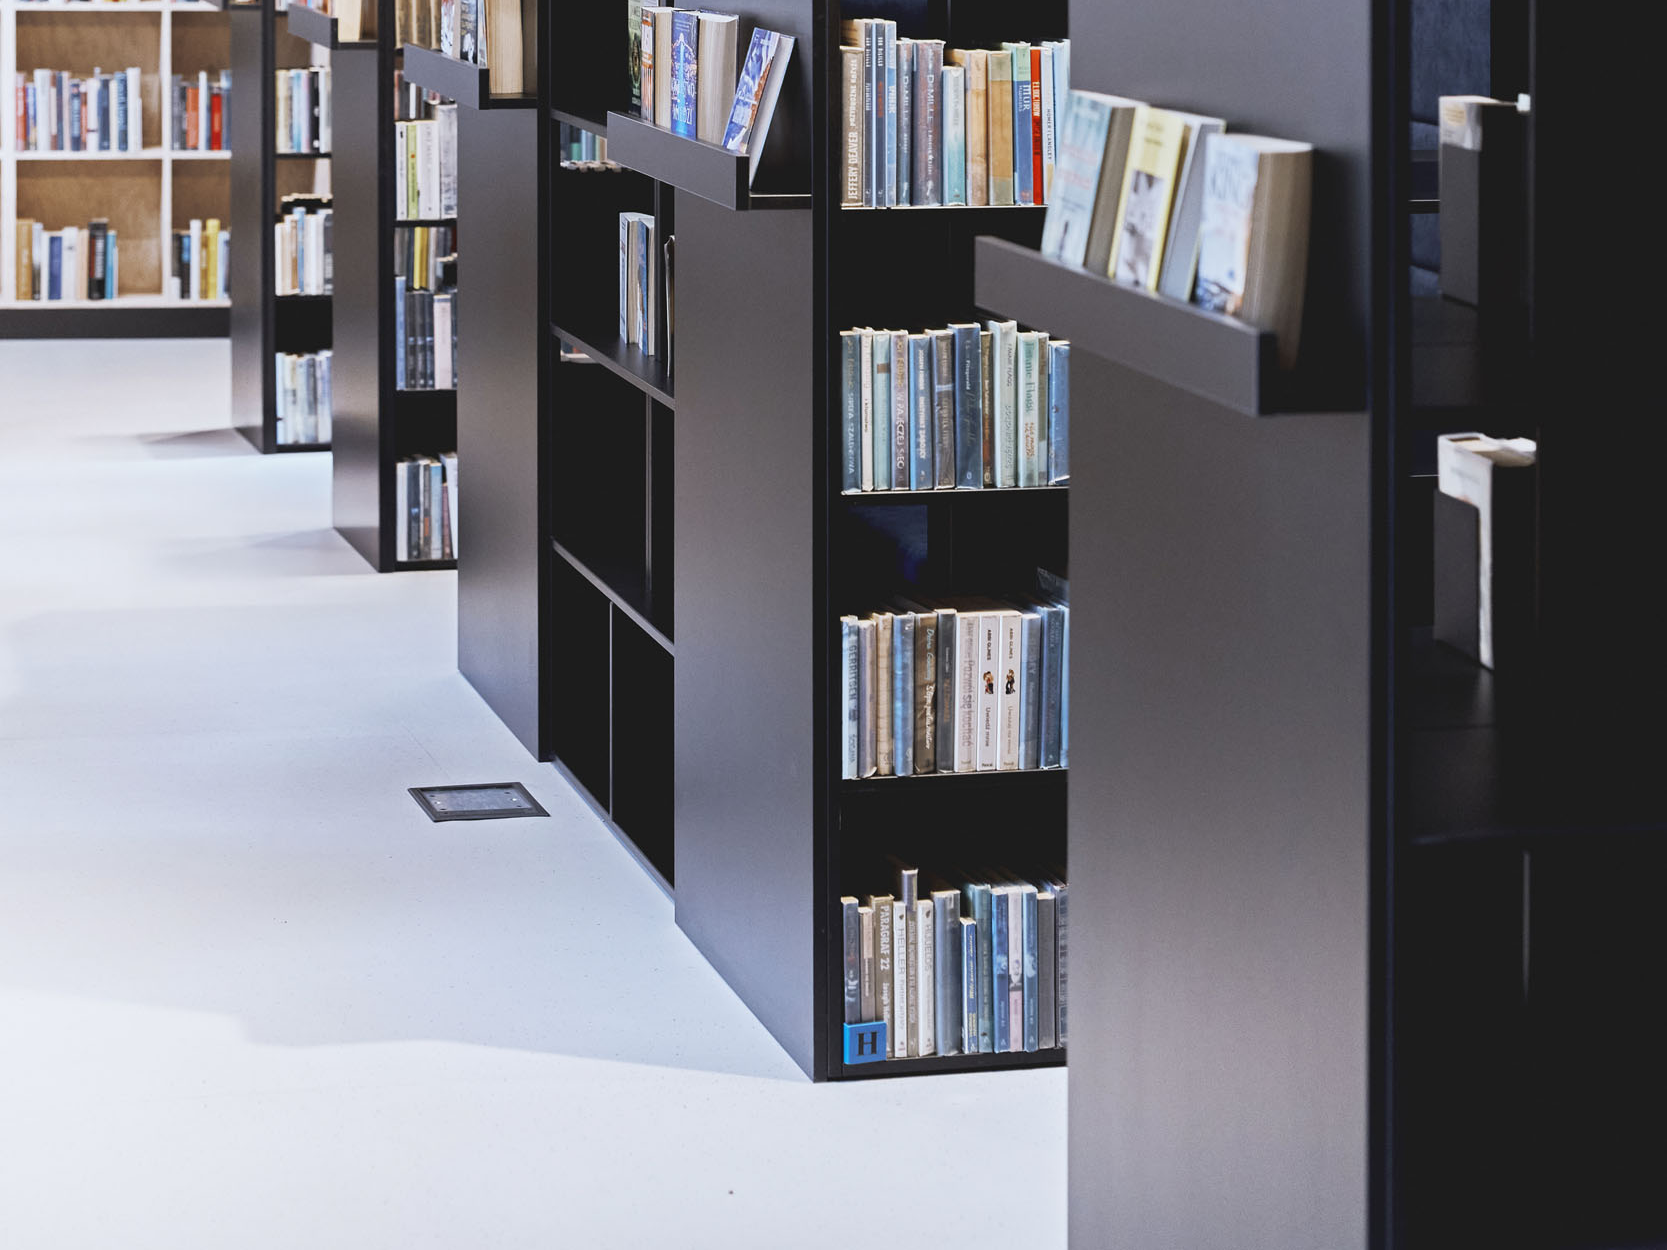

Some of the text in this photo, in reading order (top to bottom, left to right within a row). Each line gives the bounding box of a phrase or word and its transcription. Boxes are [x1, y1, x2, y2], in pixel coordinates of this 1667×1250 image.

[848, 131, 858, 164] DEAVER
[848, 166, 858, 199] JEFFERY
[1024, 381, 1036, 414] Flagg
[849, 645, 857, 700] GERRITSEN
[960, 694, 975, 709] się
[962, 710, 975, 747] kochać
[880, 905, 890, 955] PARAGRAF
[880, 957, 890, 971] 22
[897, 928, 906, 975] HELLER
[856, 1030, 878, 1057] H
